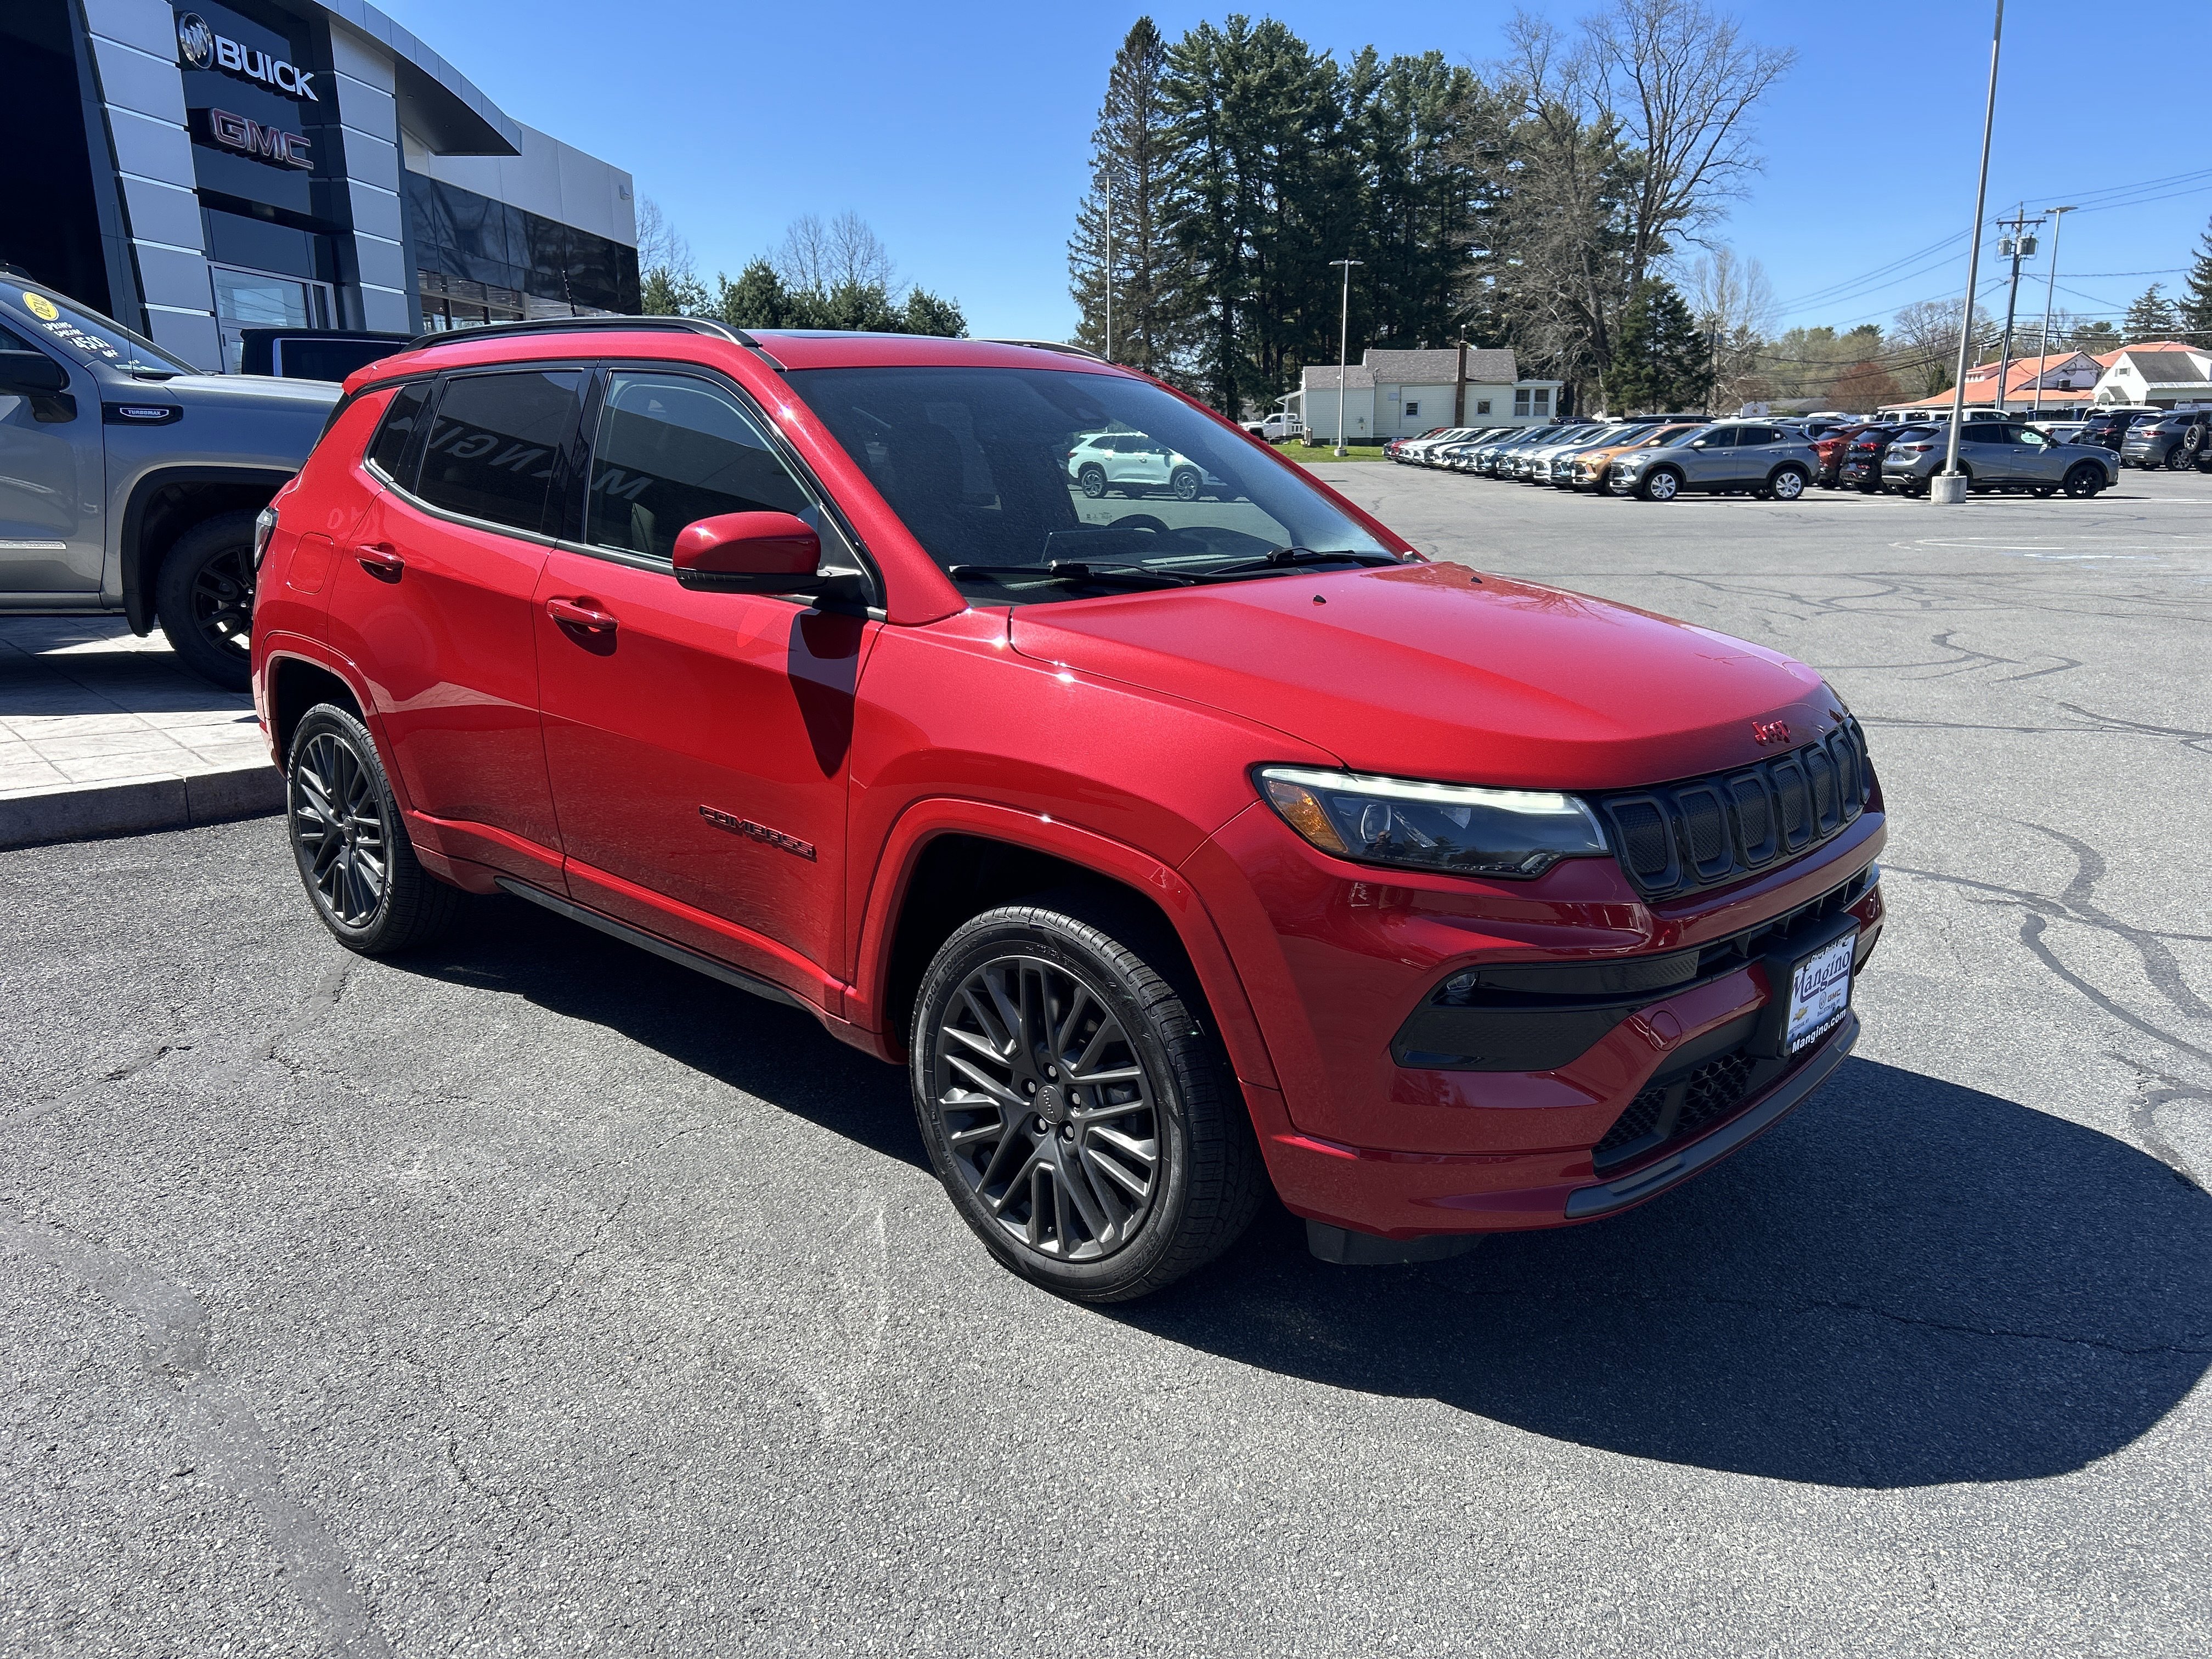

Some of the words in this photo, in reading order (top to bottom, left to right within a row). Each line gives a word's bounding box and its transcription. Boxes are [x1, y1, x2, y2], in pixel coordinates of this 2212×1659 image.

[215, 35, 319, 101] BUICK
[210, 108, 314, 170] GMC
[102, 349, 119, 358] OFF
[698, 804, 817, 857] COMPASS
[1793, 950, 1851, 1004] Mangino
[1827, 988, 1842, 1003] GMC
[1791, 1008, 1846, 1054] Mangino.com
